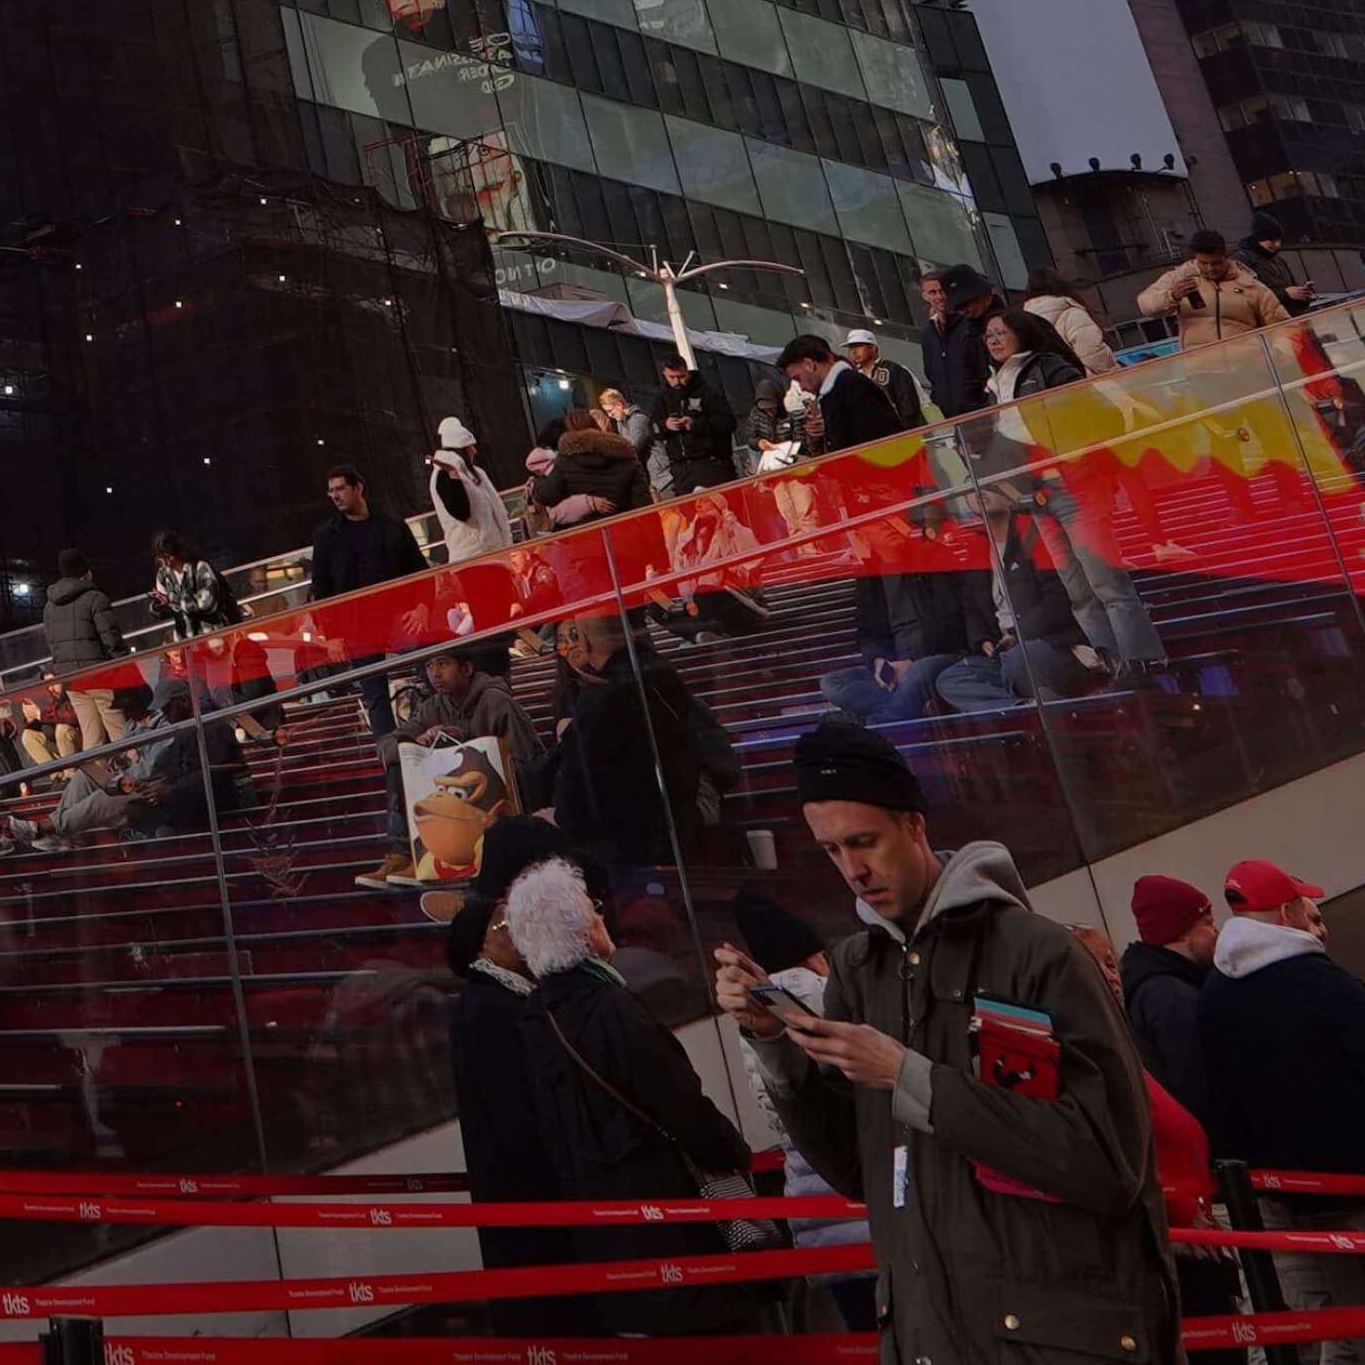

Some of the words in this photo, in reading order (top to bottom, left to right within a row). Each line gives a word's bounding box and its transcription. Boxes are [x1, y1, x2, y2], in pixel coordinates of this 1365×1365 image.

[79, 1201, 101, 1220] tkts
[349, 1281, 374, 1302] tkts
[2, 1292, 30, 1315] tkts
[104, 1341, 135, 1365] tkts
[527, 1345, 557, 1365] tkts
